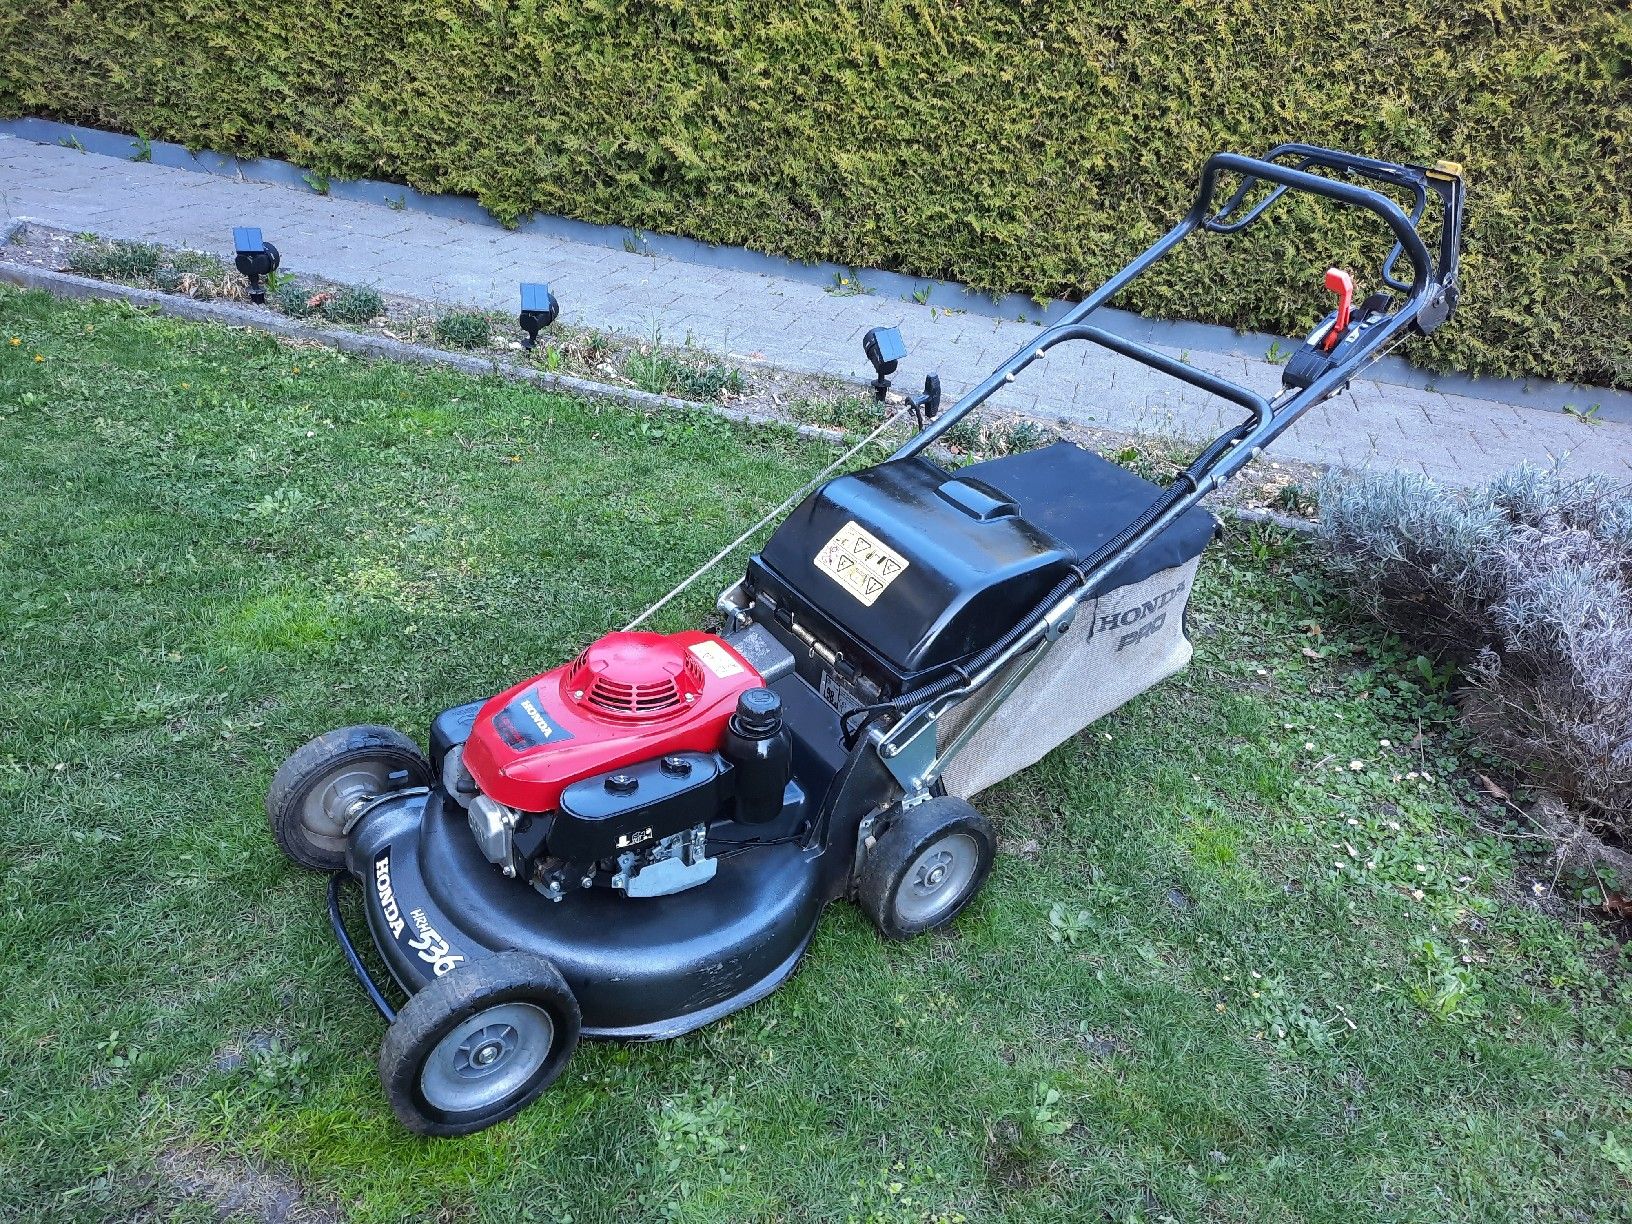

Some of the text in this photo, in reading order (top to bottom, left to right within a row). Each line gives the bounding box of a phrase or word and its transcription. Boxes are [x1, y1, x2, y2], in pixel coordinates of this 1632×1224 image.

[1097, 580, 1185, 632] HONDA
[1115, 612, 1166, 652] PRO
[520, 699, 553, 738] HONDA
[375, 856, 405, 940] HONDA
[408, 929, 465, 977] 536
